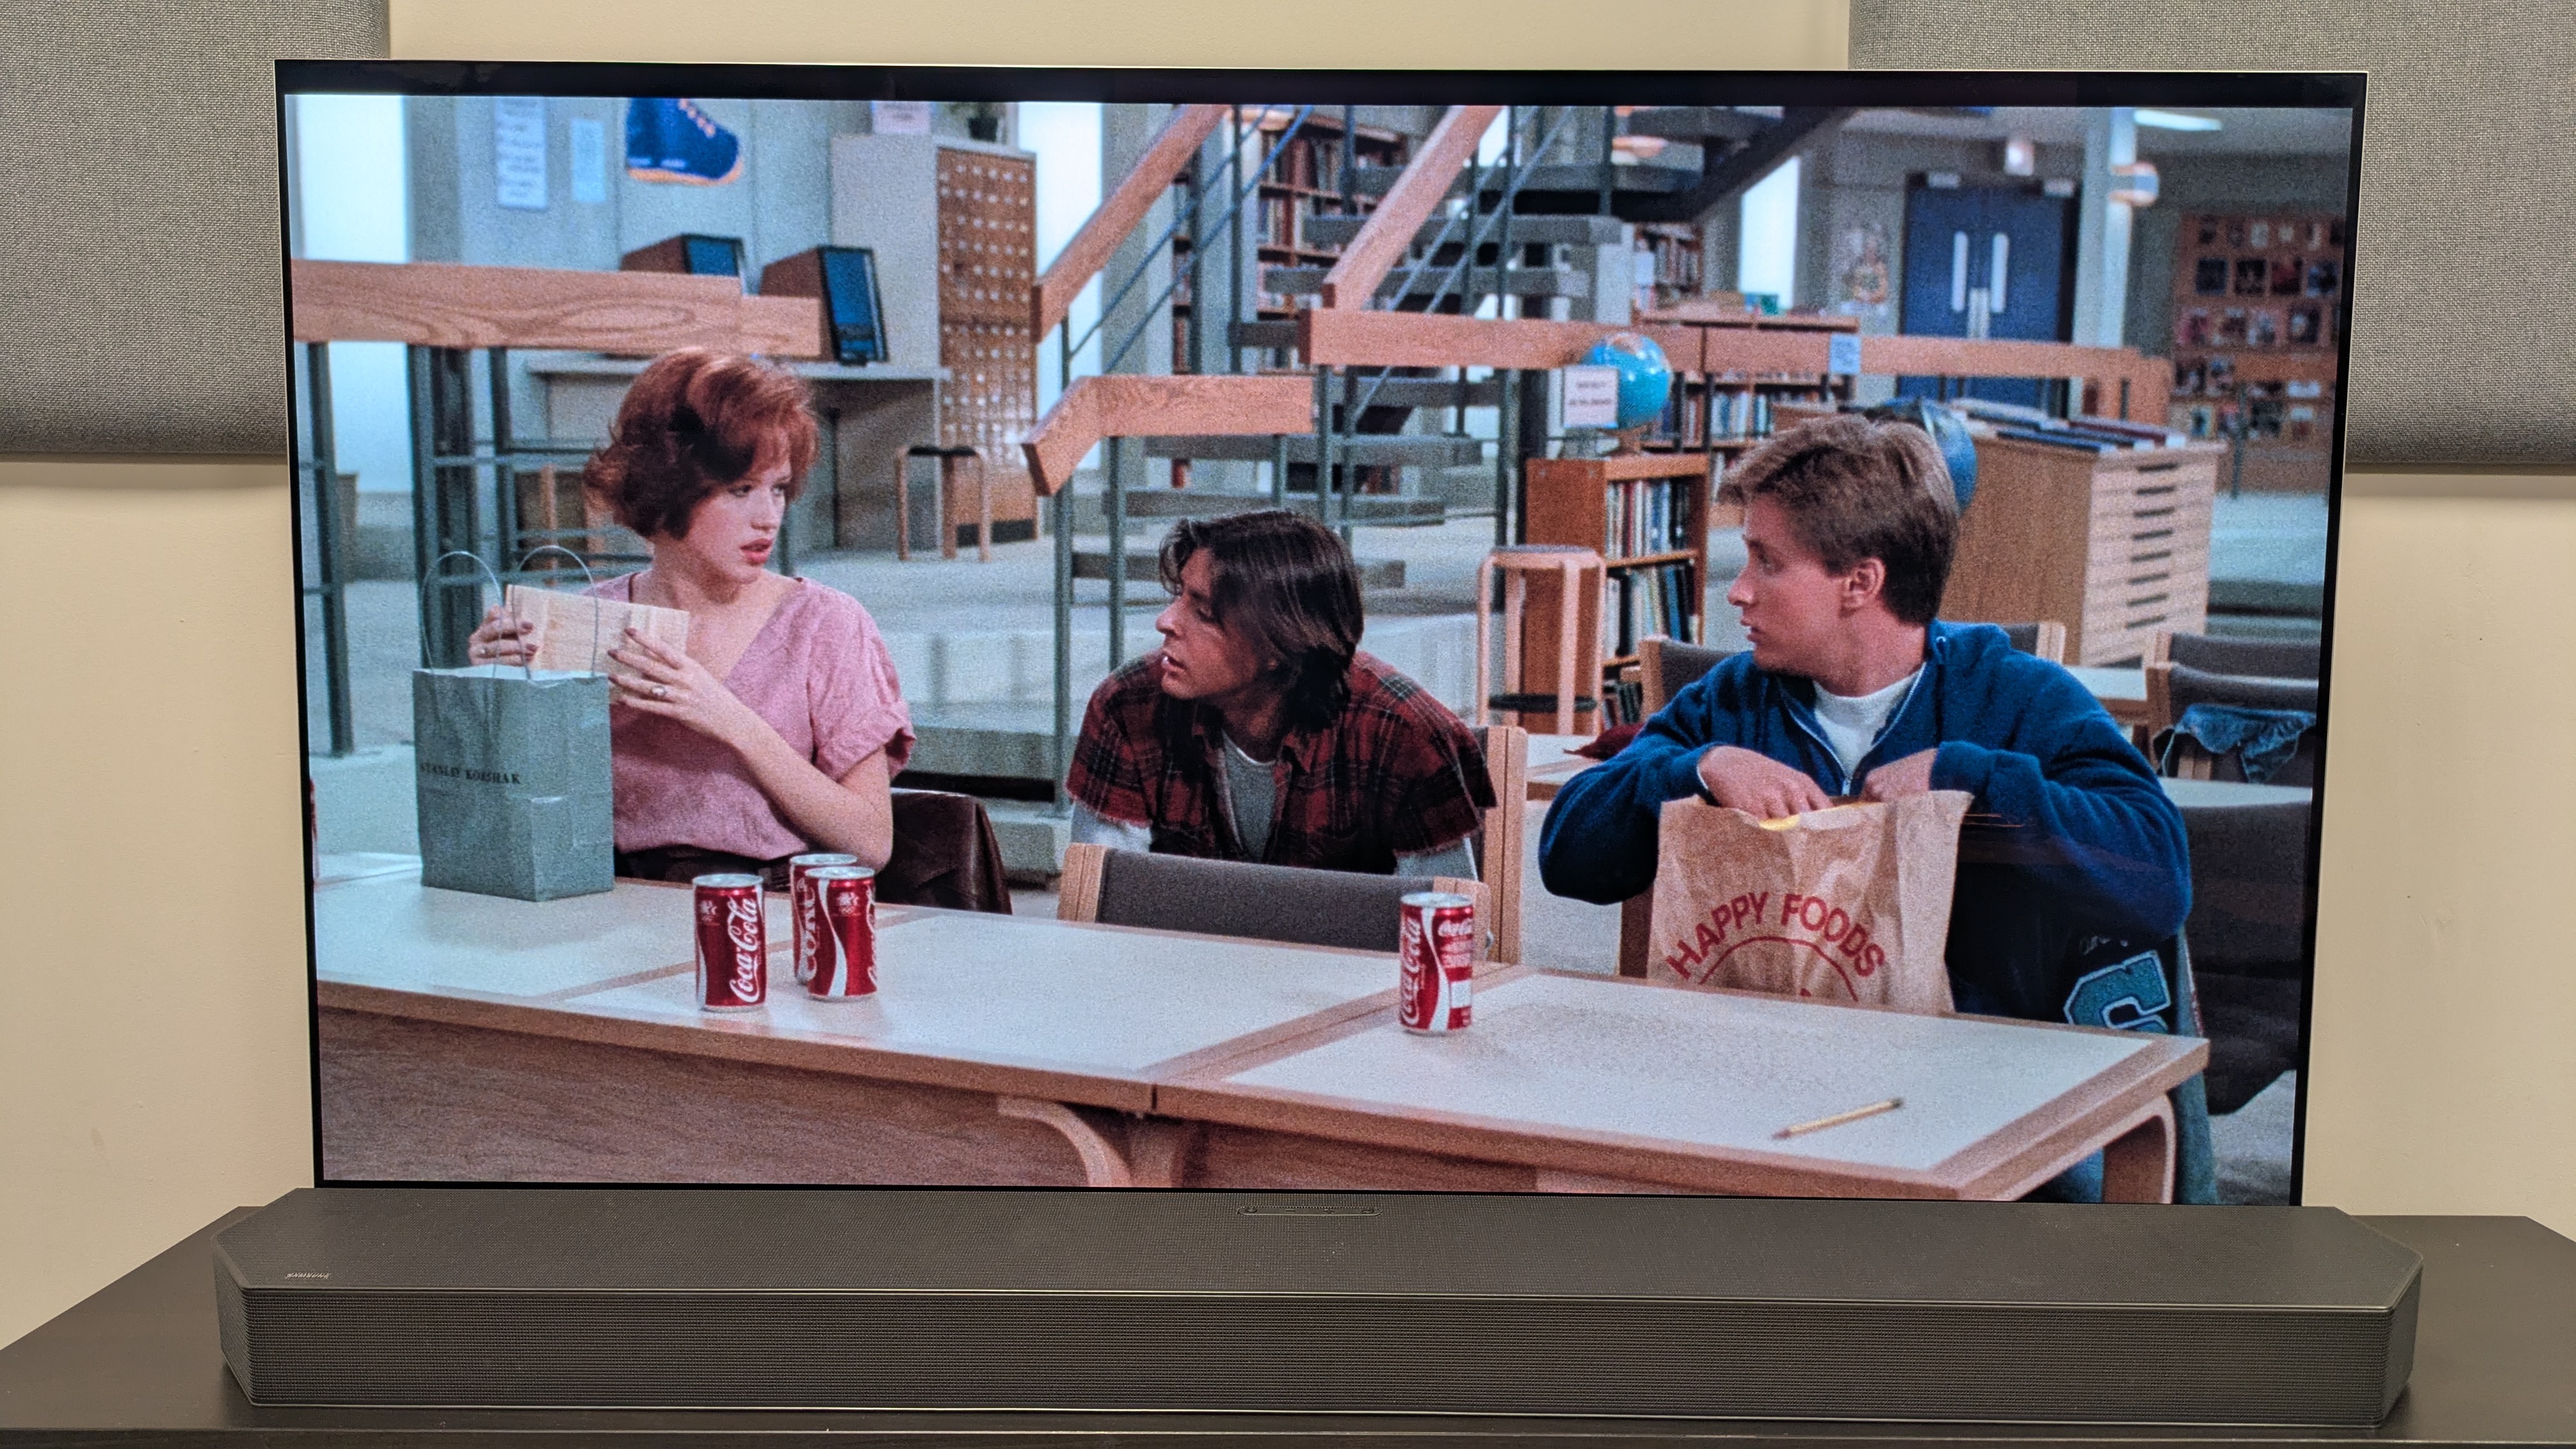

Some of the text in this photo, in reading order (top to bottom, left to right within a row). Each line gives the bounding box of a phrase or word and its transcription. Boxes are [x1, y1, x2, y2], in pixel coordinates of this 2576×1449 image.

[727, 896, 760, 1003] Coca-Cola
[1666, 891, 1885, 979] HAPPY FOODS
